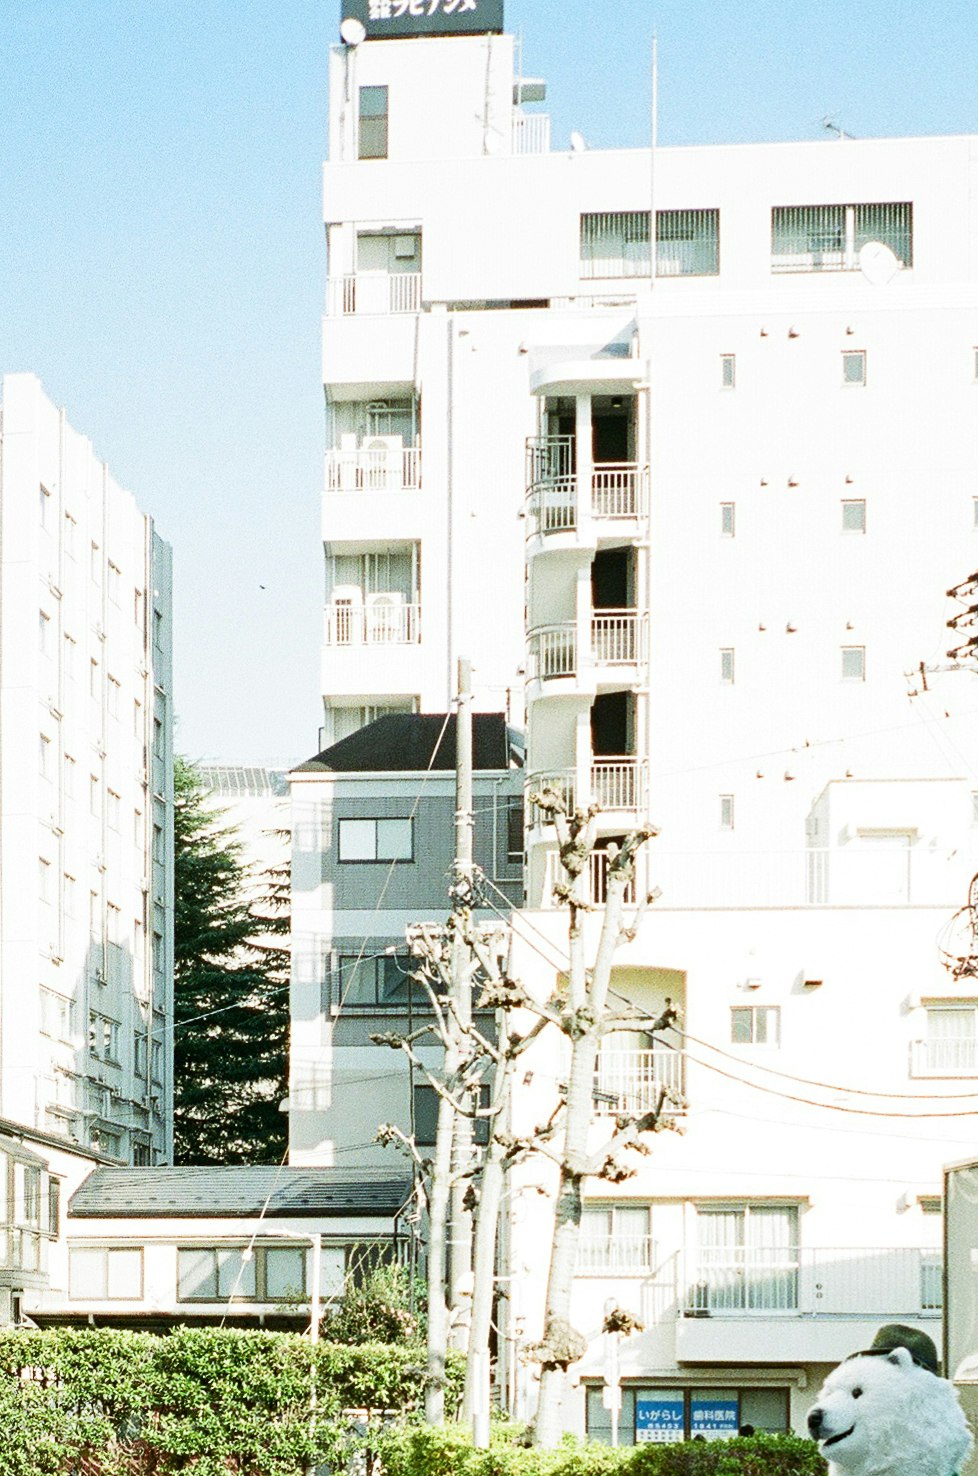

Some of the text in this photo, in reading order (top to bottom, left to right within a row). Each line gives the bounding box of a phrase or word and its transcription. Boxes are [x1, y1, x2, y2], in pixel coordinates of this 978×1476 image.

[639, 1409, 736, 1421] いがらし 歯科医院
